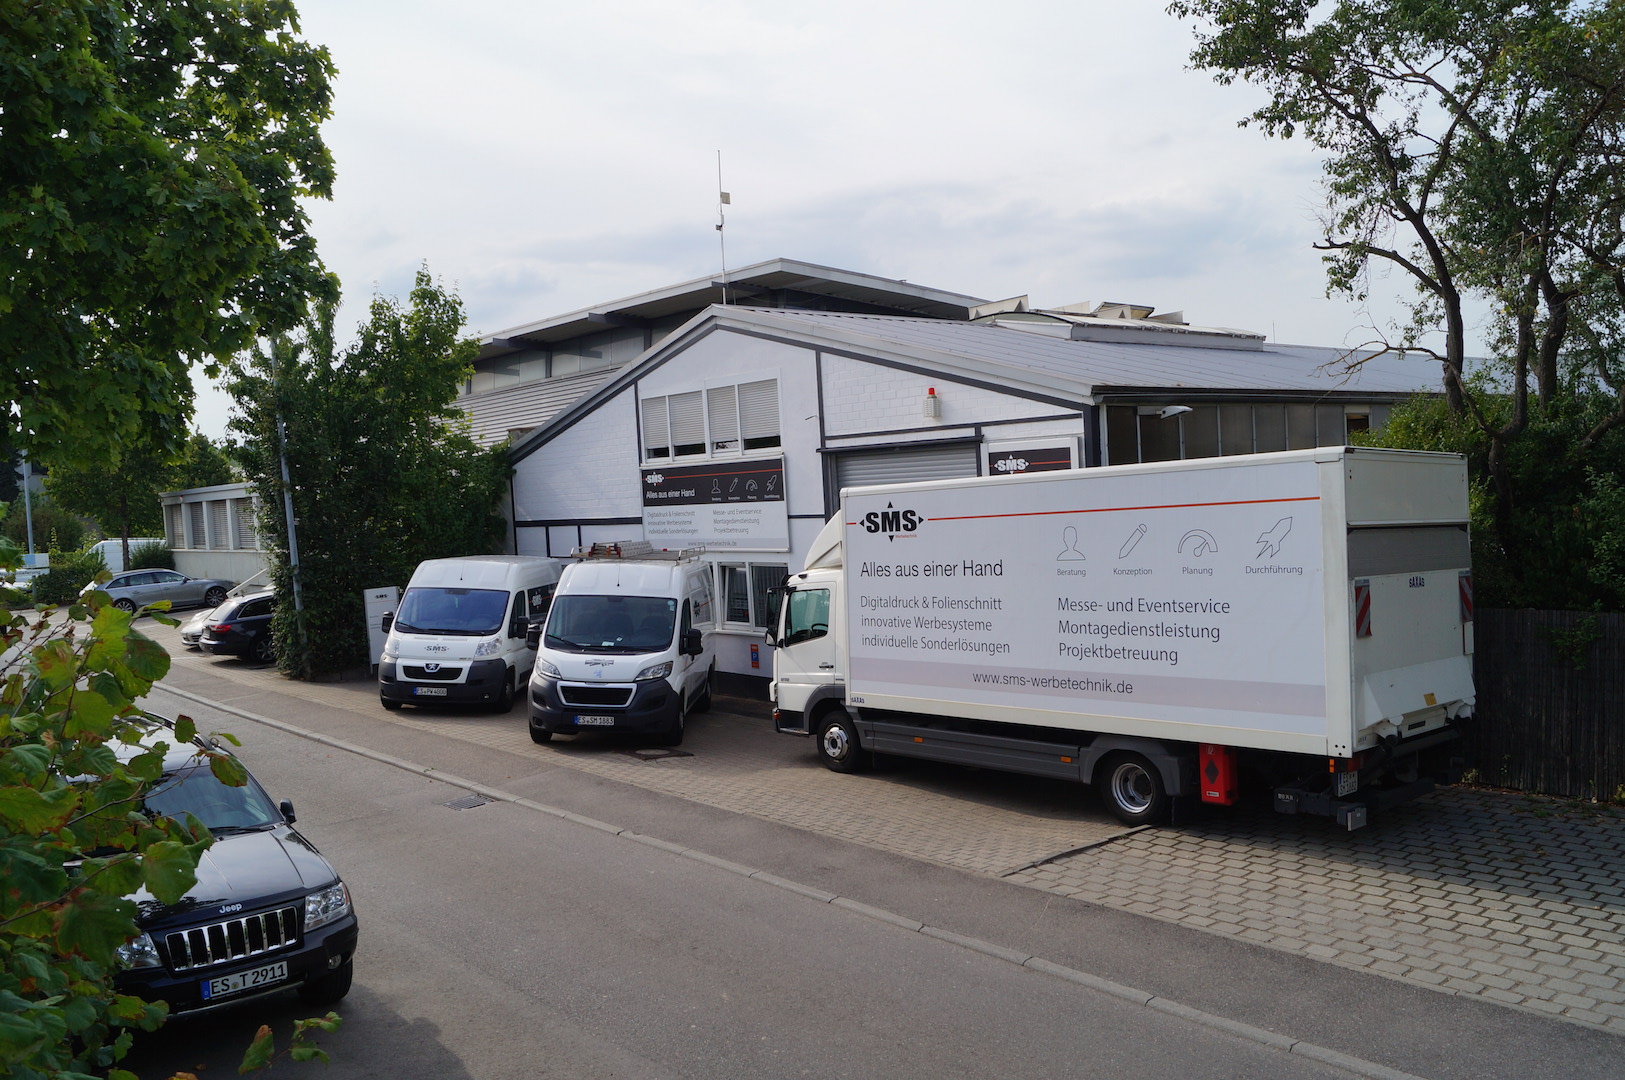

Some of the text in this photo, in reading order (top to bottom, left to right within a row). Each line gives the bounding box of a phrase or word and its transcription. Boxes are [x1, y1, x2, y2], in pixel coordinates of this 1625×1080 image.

[997, 459, 1026, 471] SMS
[647, 474, 663, 483] SMS
[646, 491, 658, 499] Alles
[668, 490, 680, 498] einer
[681, 489, 695, 497] Hand
[866, 510, 917, 533] SMS
[860, 559, 1003, 577] Alles aus einer Hand
[1057, 568, 1087, 578] Beratung
[1113, 567, 1153, 577] Konzeption
[1182, 566, 1213, 577] Planung
[1245, 565, 1303, 576] Durchführung
[860, 595, 1002, 611] Digitaldruck & Folienschnitt
[1057, 597, 1230, 614] Messe- und Eventservice
[861, 615, 992, 633] innovative Werbesysteme
[1058, 620, 1220, 642] Montagedienstleistung
[862, 634, 1010, 656] individuelle Sonderlösungen
[1059, 642, 1178, 665] Projektbetreuung
[973, 672, 1133, 694] www.sms-werbetechnik.de
[578, 716, 586, 724] ES
[219, 902, 242, 914] Jeep
[211, 978, 230, 995] ES
[240, 973, 248, 987] T
[252, 964, 286, 984] 2911
